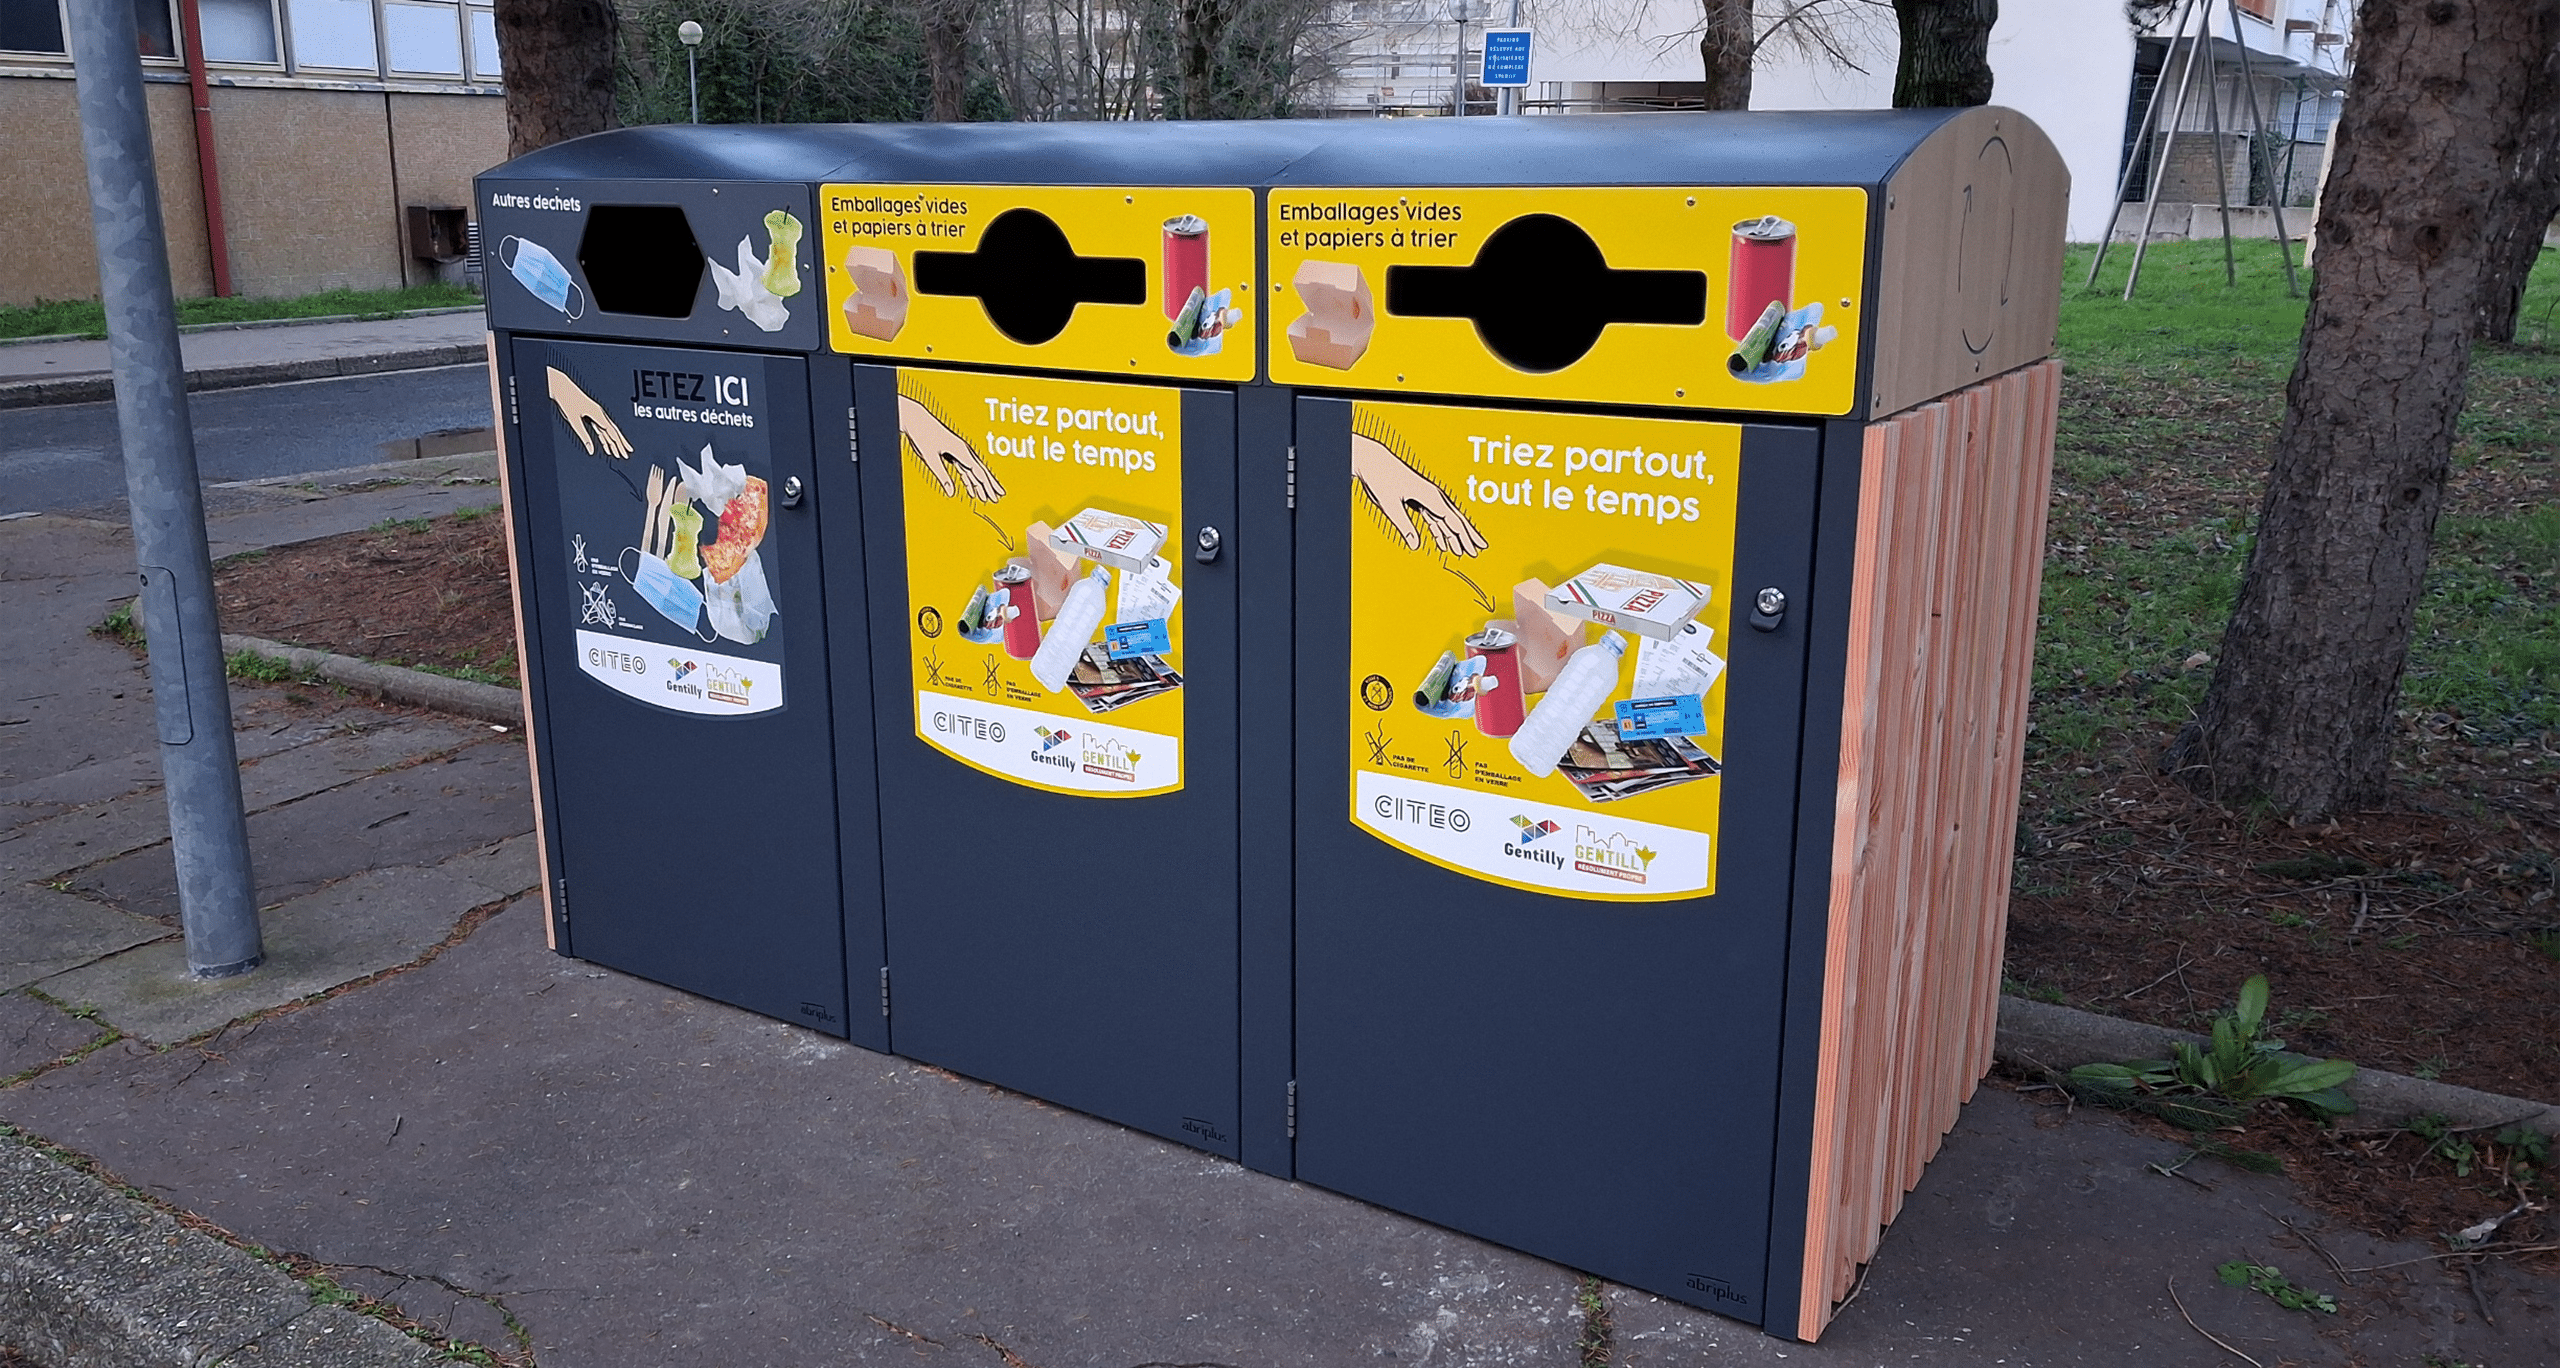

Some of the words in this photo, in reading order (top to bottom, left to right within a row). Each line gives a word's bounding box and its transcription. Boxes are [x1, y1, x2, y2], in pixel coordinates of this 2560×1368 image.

[492, 192, 530, 209] Autres
[532, 195, 581, 212] dechets
[831, 196, 921, 217] Emballages
[925, 197, 968, 214] vides
[1280, 202, 1399, 225] Emballages
[1405, 201, 1462, 221] vides
[833, 219, 848, 234] et
[852, 218, 912, 238] papiers
[916, 219, 927, 236] à
[931, 220, 966, 237] trier
[1280, 229, 1299, 246] et
[1305, 228, 1384, 250] papiers
[1391, 228, 1404, 247] à
[1411, 228, 1458, 247] trier
[630, 369, 706, 402] JETEZ
[714, 375, 749, 407] ICI
[633, 402, 652, 418] les
[655, 406, 697, 423] autres
[700, 408, 754, 428] déchets
[984, 396, 1049, 427] Triez
[1057, 407, 1164, 441] partout,
[985, 431, 1036, 459] tout
[1043, 435, 1066, 462] le
[1072, 439, 1156, 475] temps
[1467, 435, 1555, 468] Triez
[1564, 445, 1714, 485] partout,
[1466, 474, 1533, 507] tout
[1543, 479, 1574, 510] le
[1584, 484, 1700, 525] temps
[1622, 589, 1665, 613] PIZZA
[1592, 609, 1616, 625] PIZZA
[589, 647, 646, 675] CITEO
[666, 680, 703, 699] Gentilly
[933, 711, 1006, 743] CITEO
[1031, 750, 1076, 773] Gentilly
[1082, 749, 1141, 772] GENTILLY
[1392, 761, 1429, 773] CIGARETTE
[1475, 769, 1522, 782] D'EMBALLAGE
[1485, 778, 1509, 787] VERRE
[1375, 794, 1470, 833] CITEO
[1504, 842, 1565, 870] Gentilly
[1575, 844, 1657, 872] GENTILLY
[1182, 1120, 1227, 1143] abriplus
[1686, 1277, 1748, 1305] abriplus
